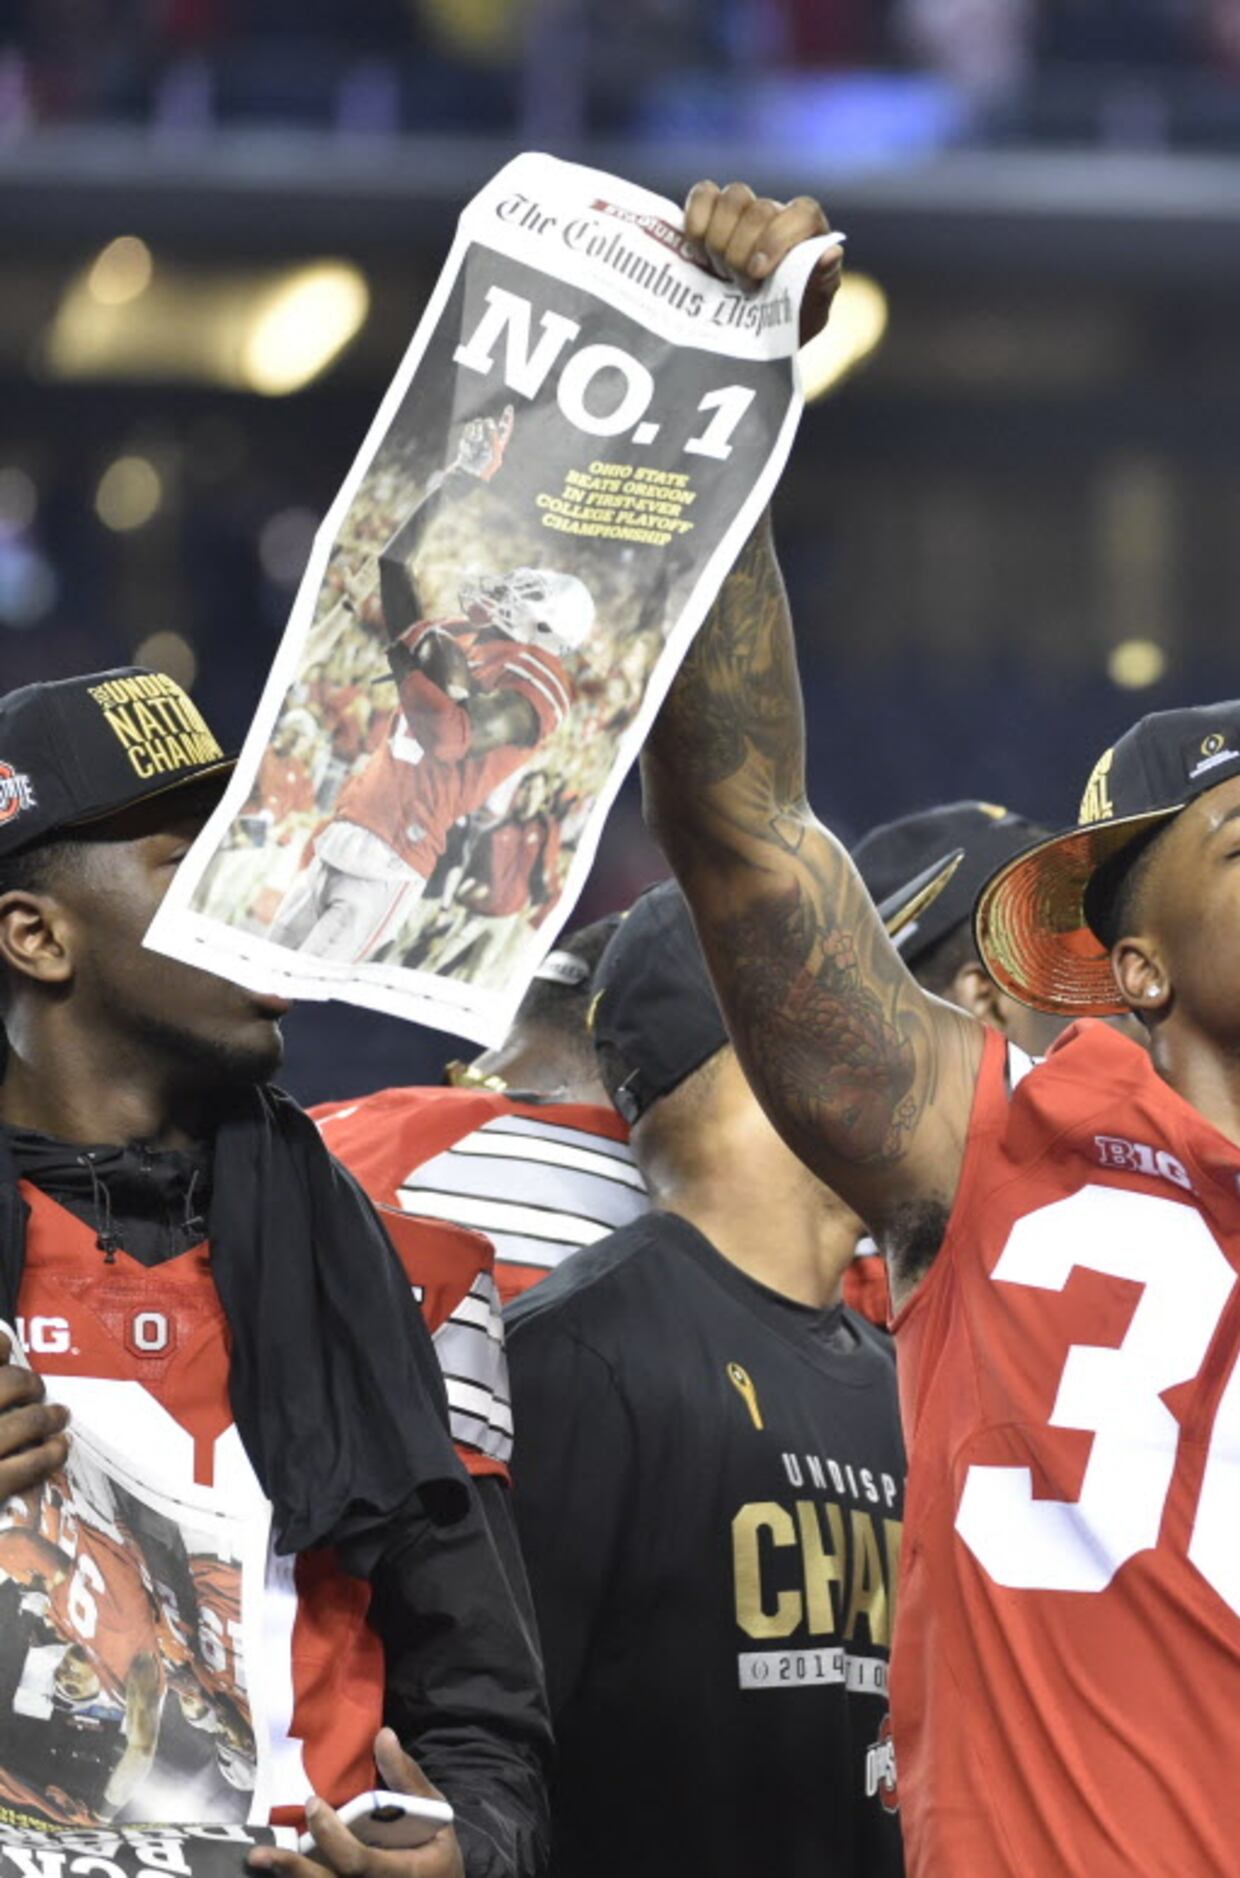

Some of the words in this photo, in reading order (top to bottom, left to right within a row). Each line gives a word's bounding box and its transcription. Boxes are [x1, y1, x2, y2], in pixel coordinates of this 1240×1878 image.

[495, 192, 557, 235] The
[562, 219, 704, 318] Columbus
[453, 286, 660, 445] NO.
[683, 384, 757, 461] 1
[565, 469, 622, 493] BEATS
[622, 480, 697, 505] OREGON
[588, 460, 633, 479] OHIO
[634, 466, 690, 488] STATE
[561, 485, 585, 502] IN
[535, 493, 615, 523] COLLEGE
[615, 509, 694, 535] PLAYOFF
[541, 512, 673, 547] CHAMPIONSHIP
[778, 1653, 844, 1681] 2014
